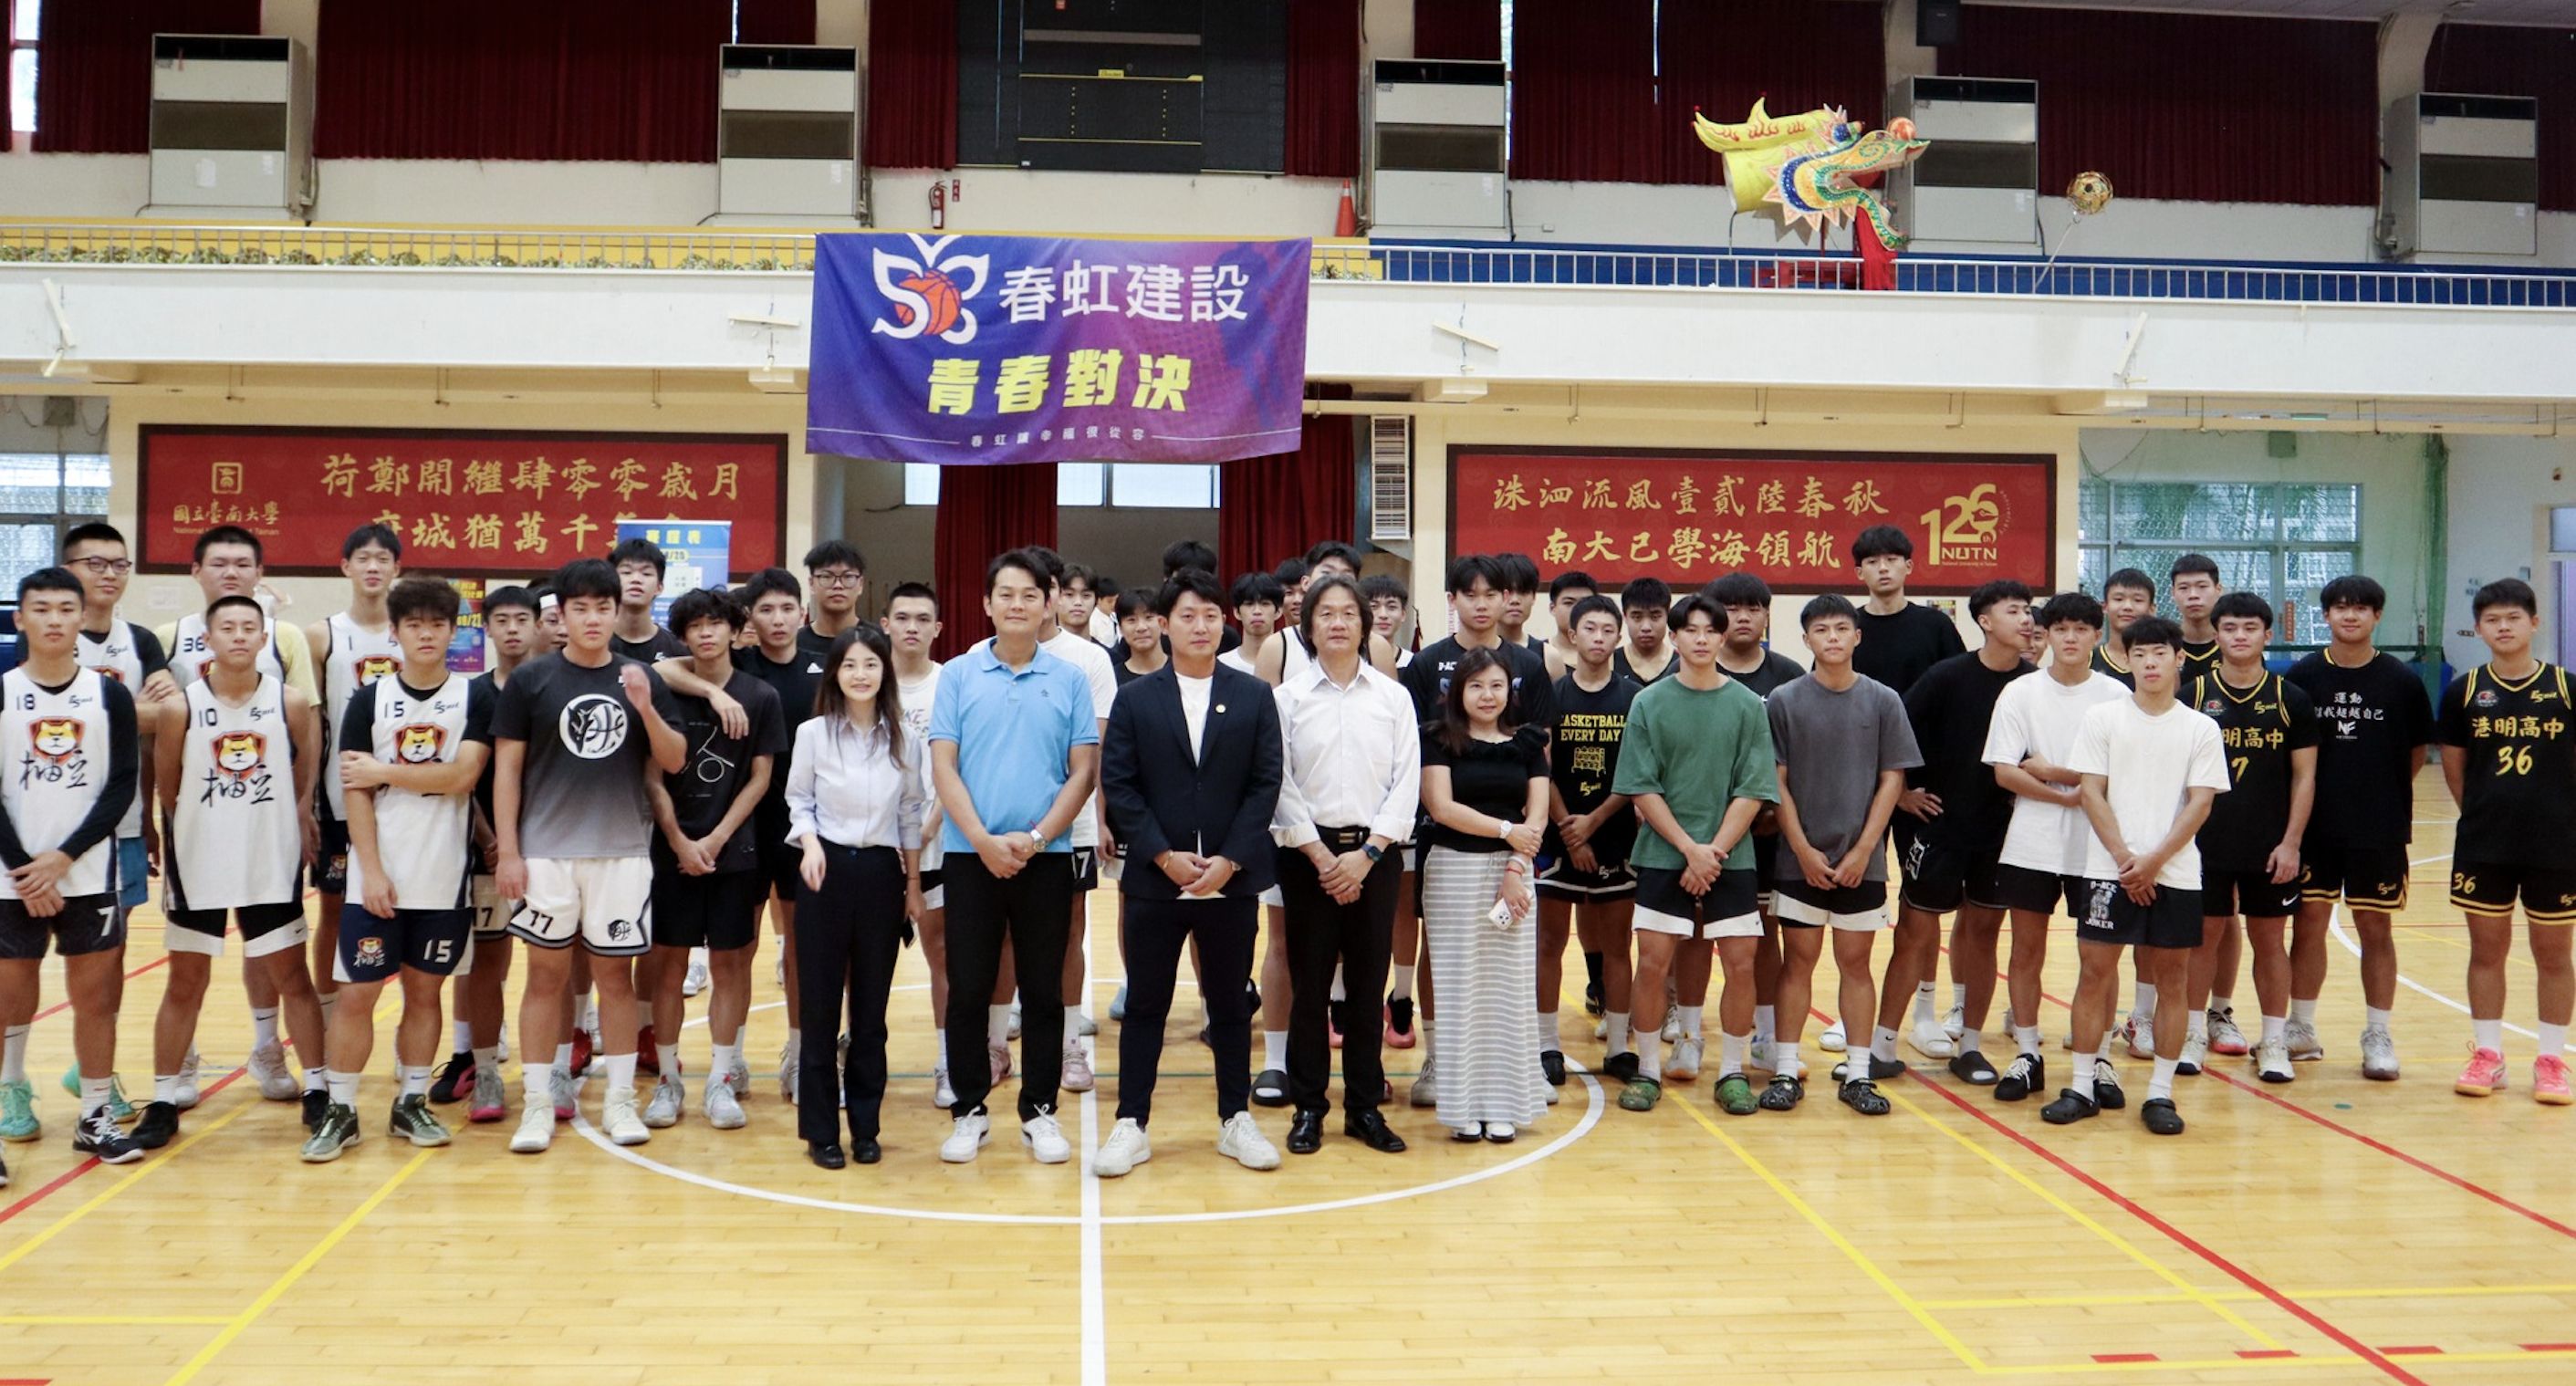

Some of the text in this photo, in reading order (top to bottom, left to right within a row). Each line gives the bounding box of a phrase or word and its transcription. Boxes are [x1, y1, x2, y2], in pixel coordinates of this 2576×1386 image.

[998, 260, 1249, 323] 春虹建設
[926, 349, 1192, 416] 青春對決
[1942, 547, 1997, 560] NUTN
[16, 693, 36, 711] 18
[384, 700, 404, 718] 15
[199, 707, 218, 727] 10
[1559, 714, 1626, 727] ASKETBALL
[2471, 715, 2564, 740] 港明高中
[1560, 729, 1622, 742] EVERY DAY
[2231, 756, 2249, 783] 7
[2496, 745, 2533, 776] 36
[2452, 872, 2476, 895] 36
[530, 909, 554, 934] 77
[423, 938, 454, 964] 15
